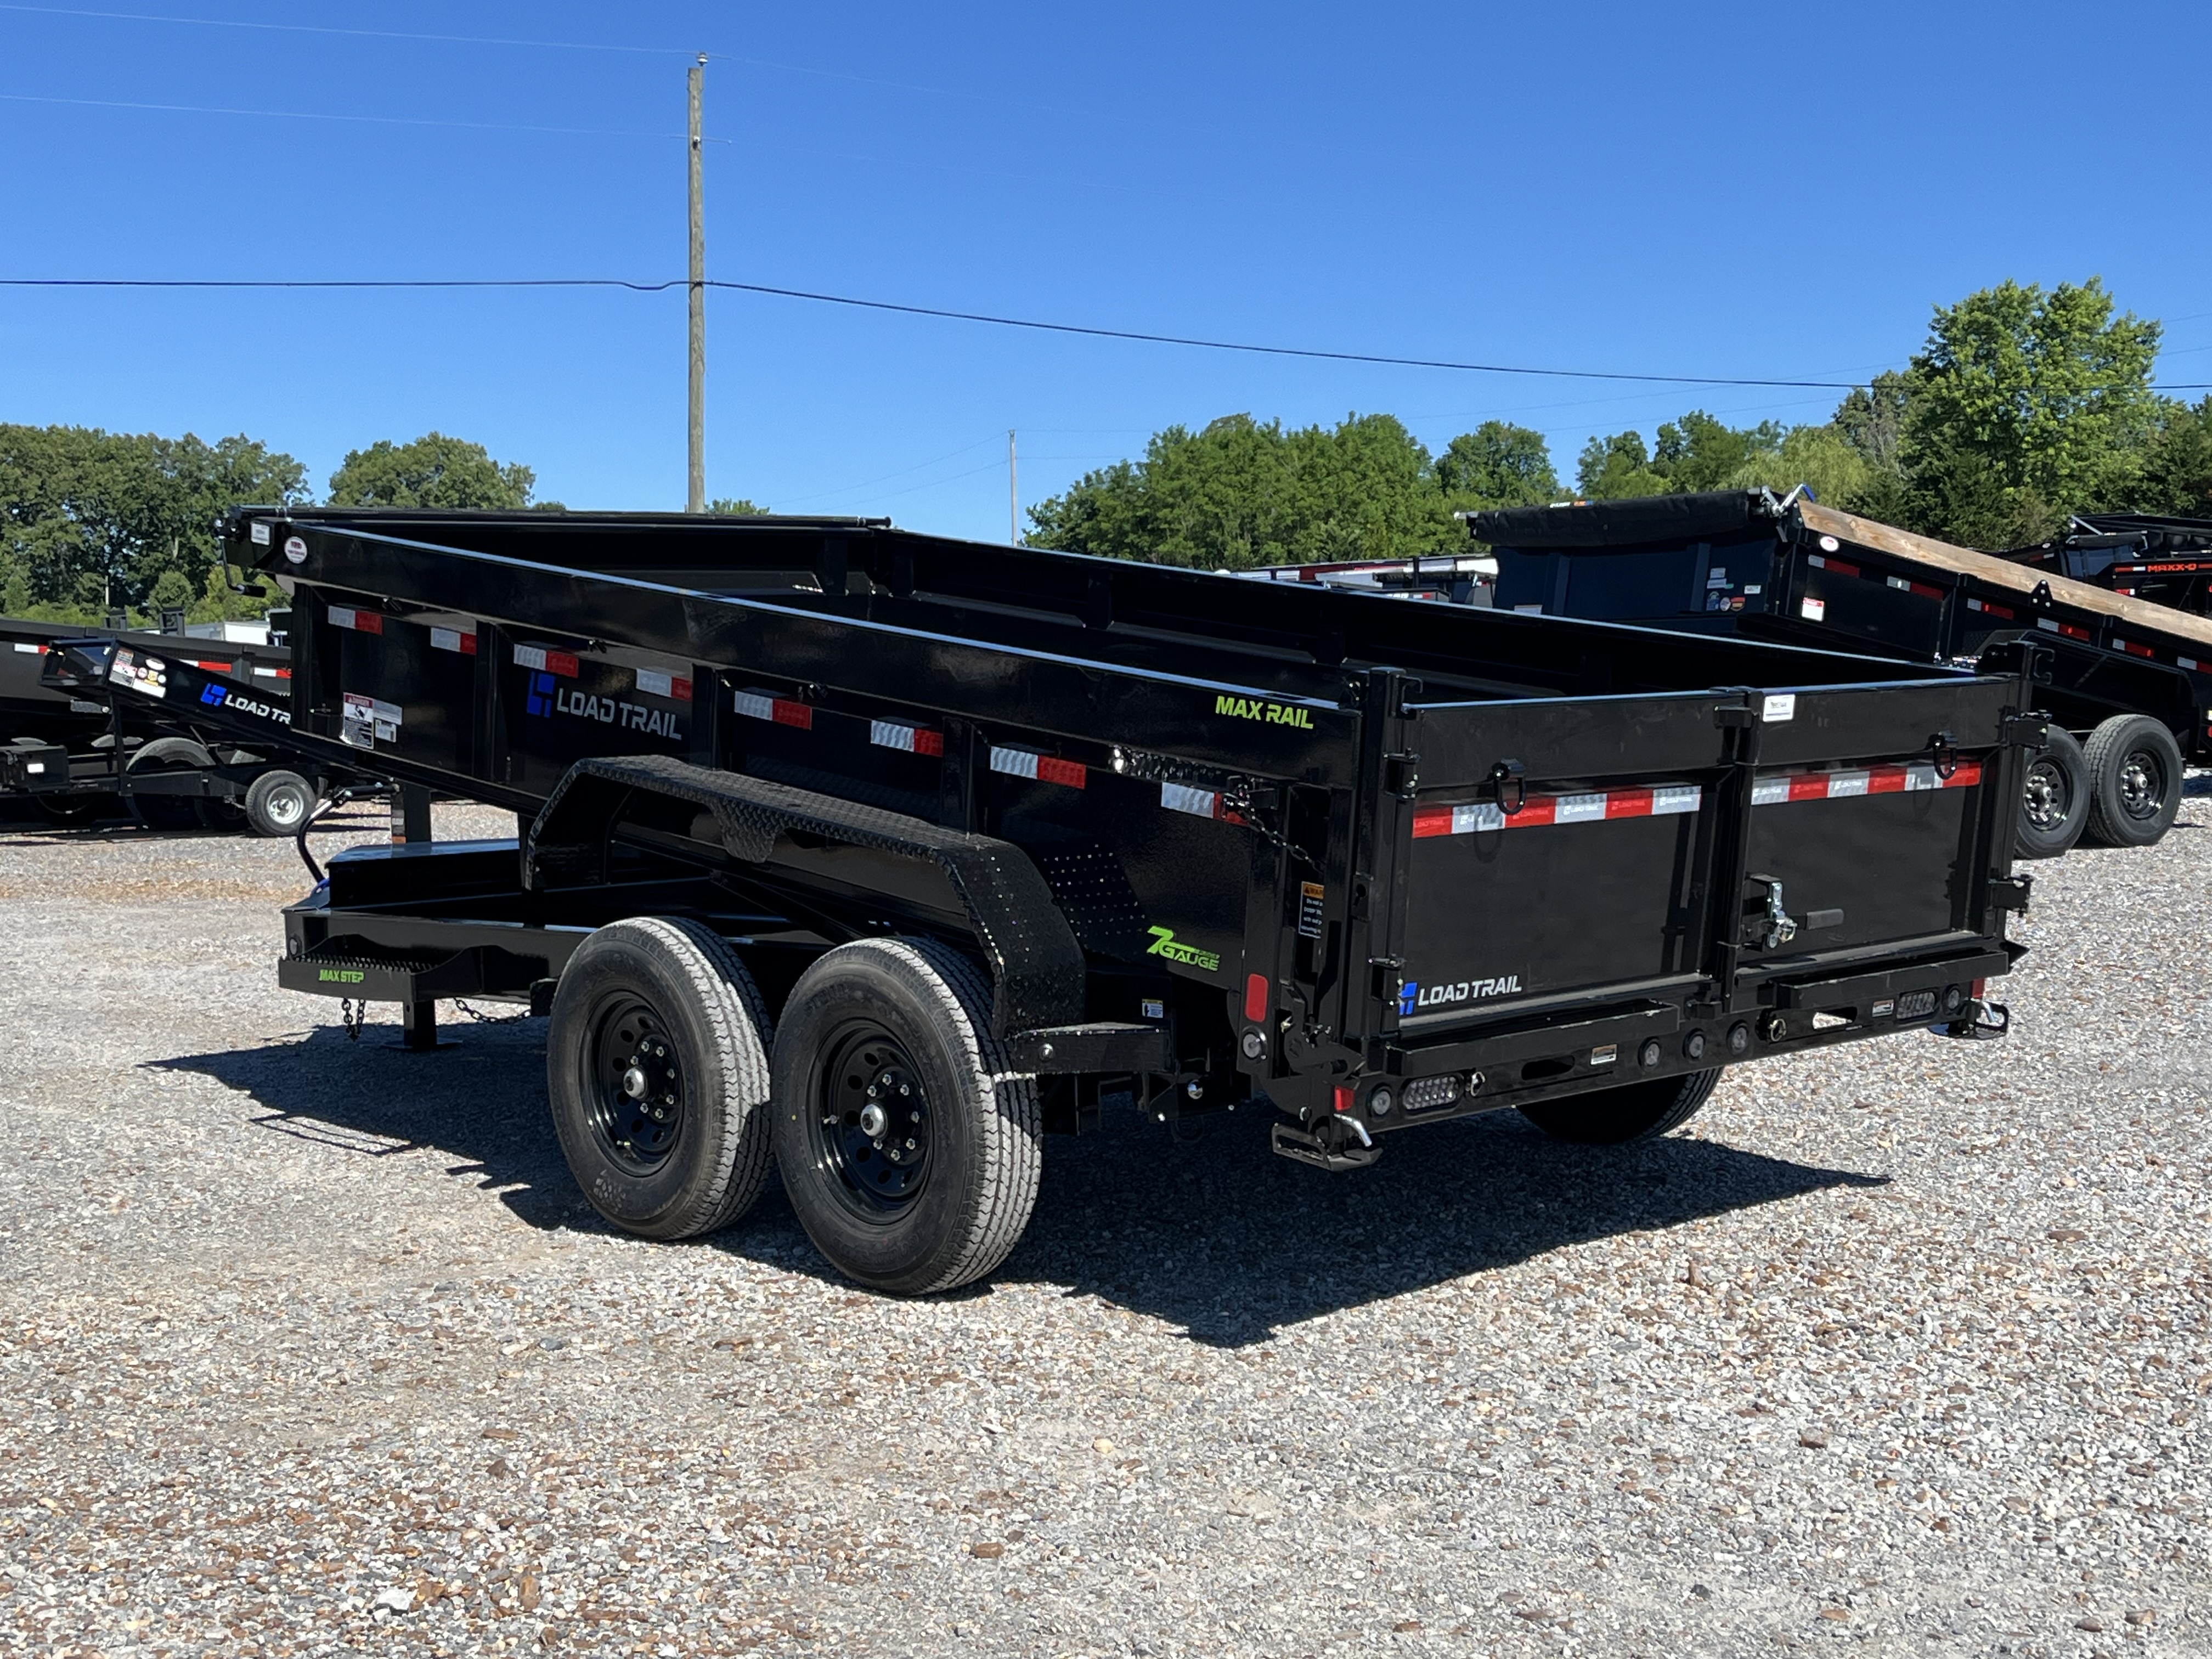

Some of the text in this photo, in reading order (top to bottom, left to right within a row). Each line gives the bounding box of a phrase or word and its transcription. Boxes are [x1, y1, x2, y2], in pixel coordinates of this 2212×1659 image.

[224, 694, 270, 717] LOAD
[557, 688, 682, 740] LOAD TRAIL
[1216, 696, 1314, 729] MAX RAIL
[1159, 941, 1220, 971] GAUGE
[319, 969, 364, 983] MAX STEP
[1418, 975, 1522, 1006] LOAD TRAIL
